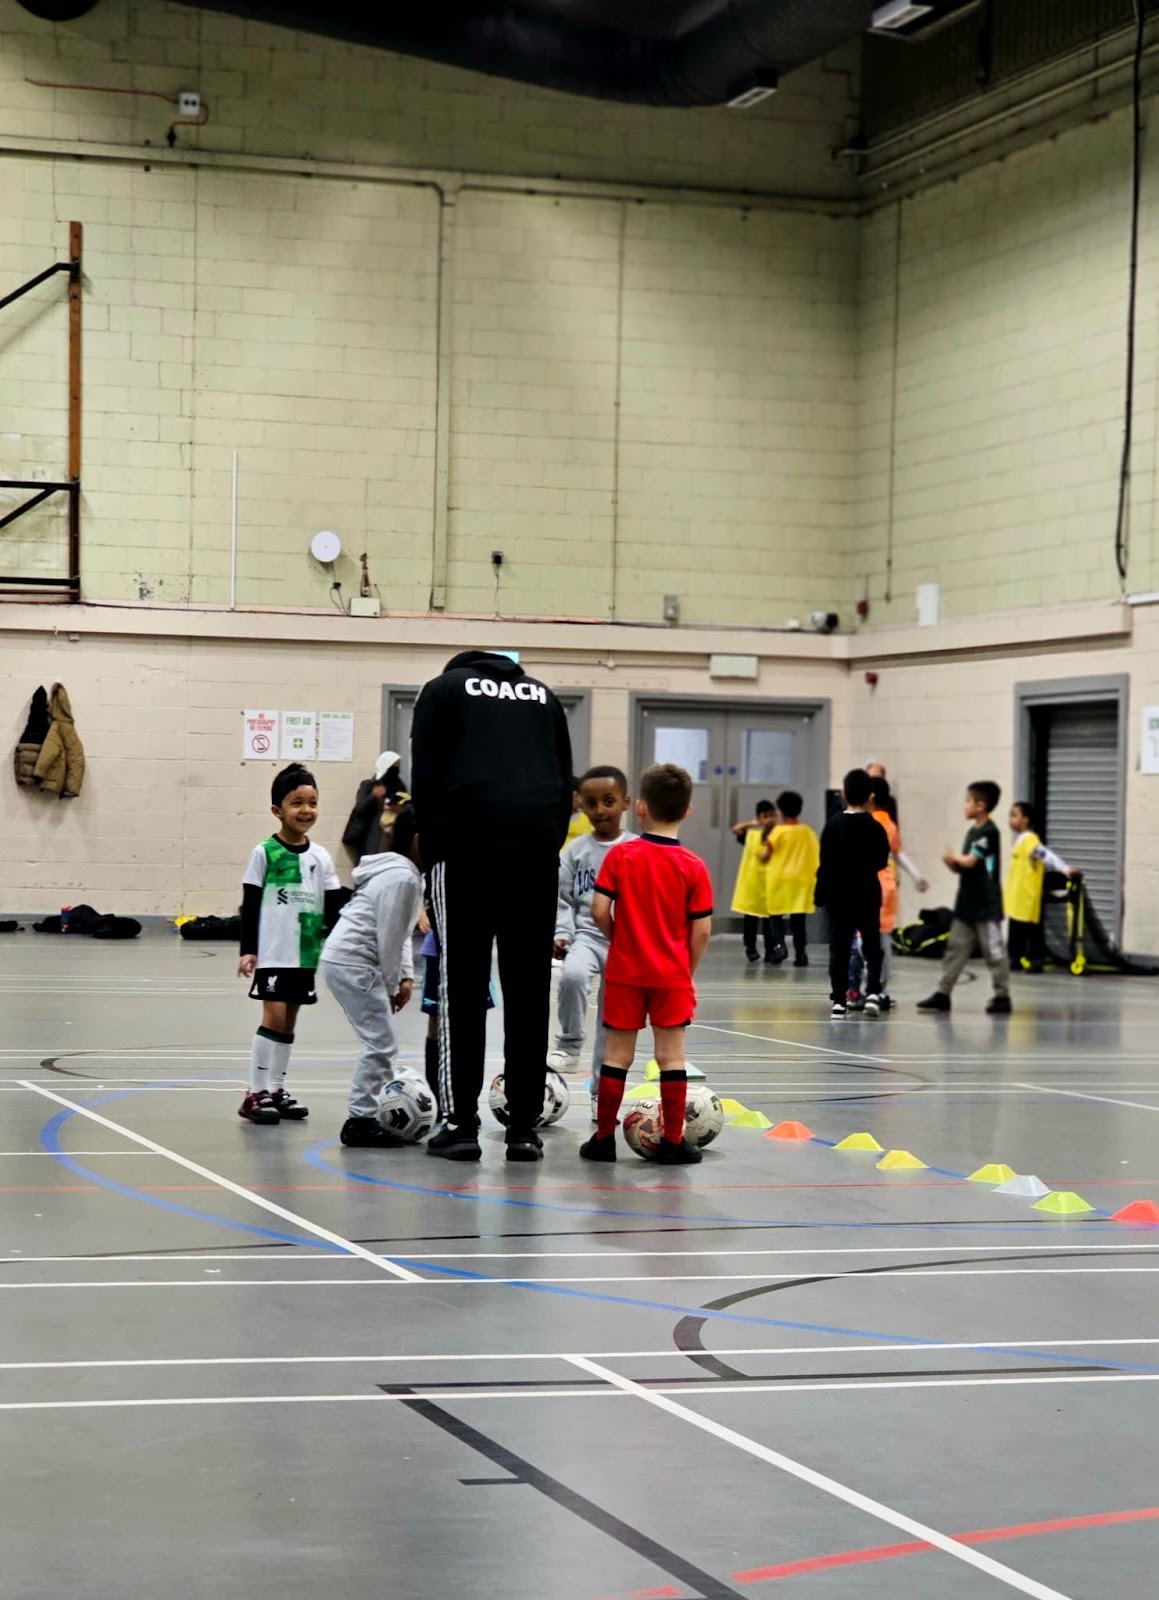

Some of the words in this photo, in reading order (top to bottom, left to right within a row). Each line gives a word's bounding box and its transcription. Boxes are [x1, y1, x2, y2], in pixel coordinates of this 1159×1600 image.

[464, 677, 547, 704] COACH
[286, 716, 301, 725] FIRST
[302, 717, 312, 725] AID
